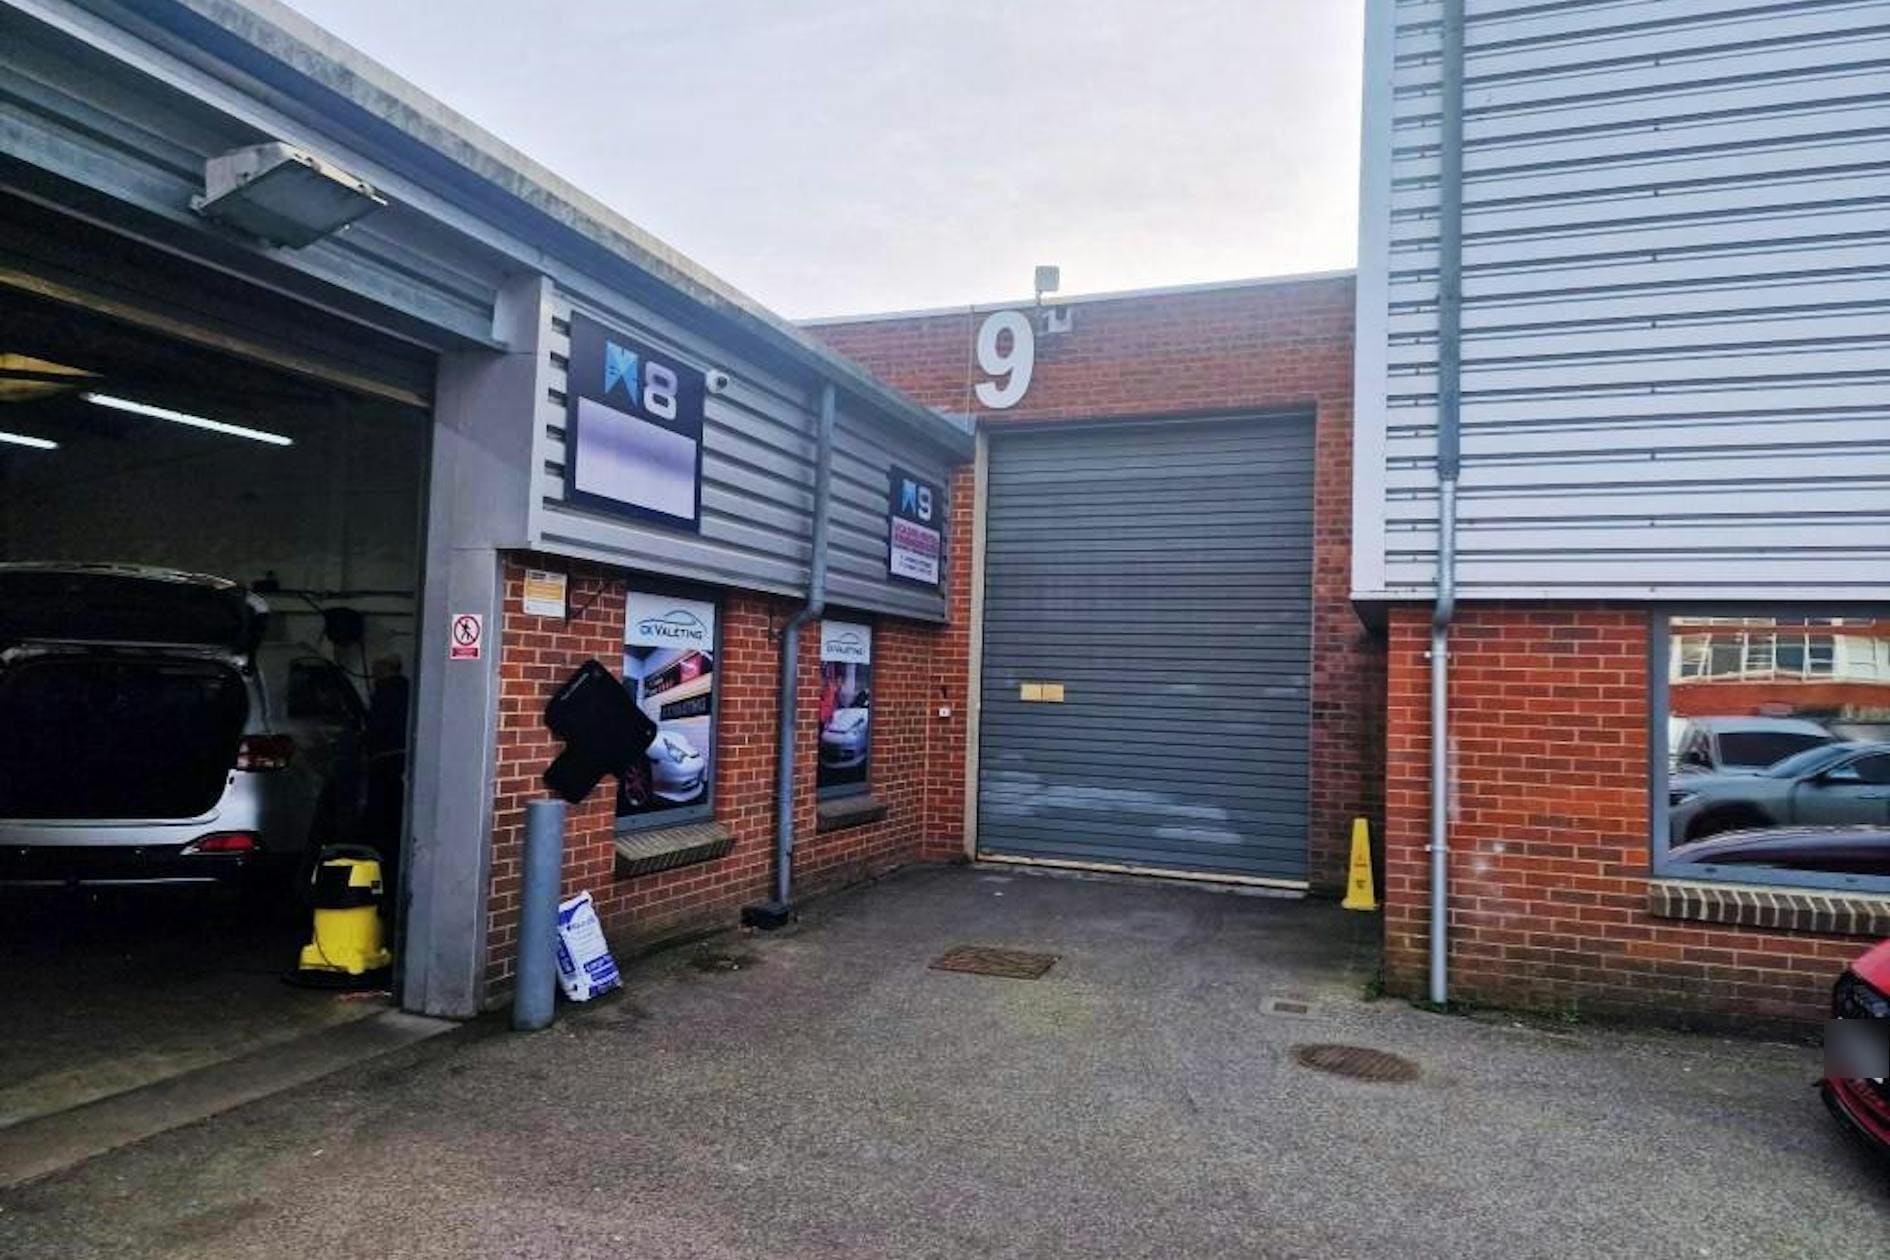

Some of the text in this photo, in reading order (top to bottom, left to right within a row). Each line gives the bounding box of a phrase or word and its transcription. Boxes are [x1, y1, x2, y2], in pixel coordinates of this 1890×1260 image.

[975, 310, 1035, 409] 9
[644, 360, 678, 420] 8
[917, 485, 932, 521] 9
